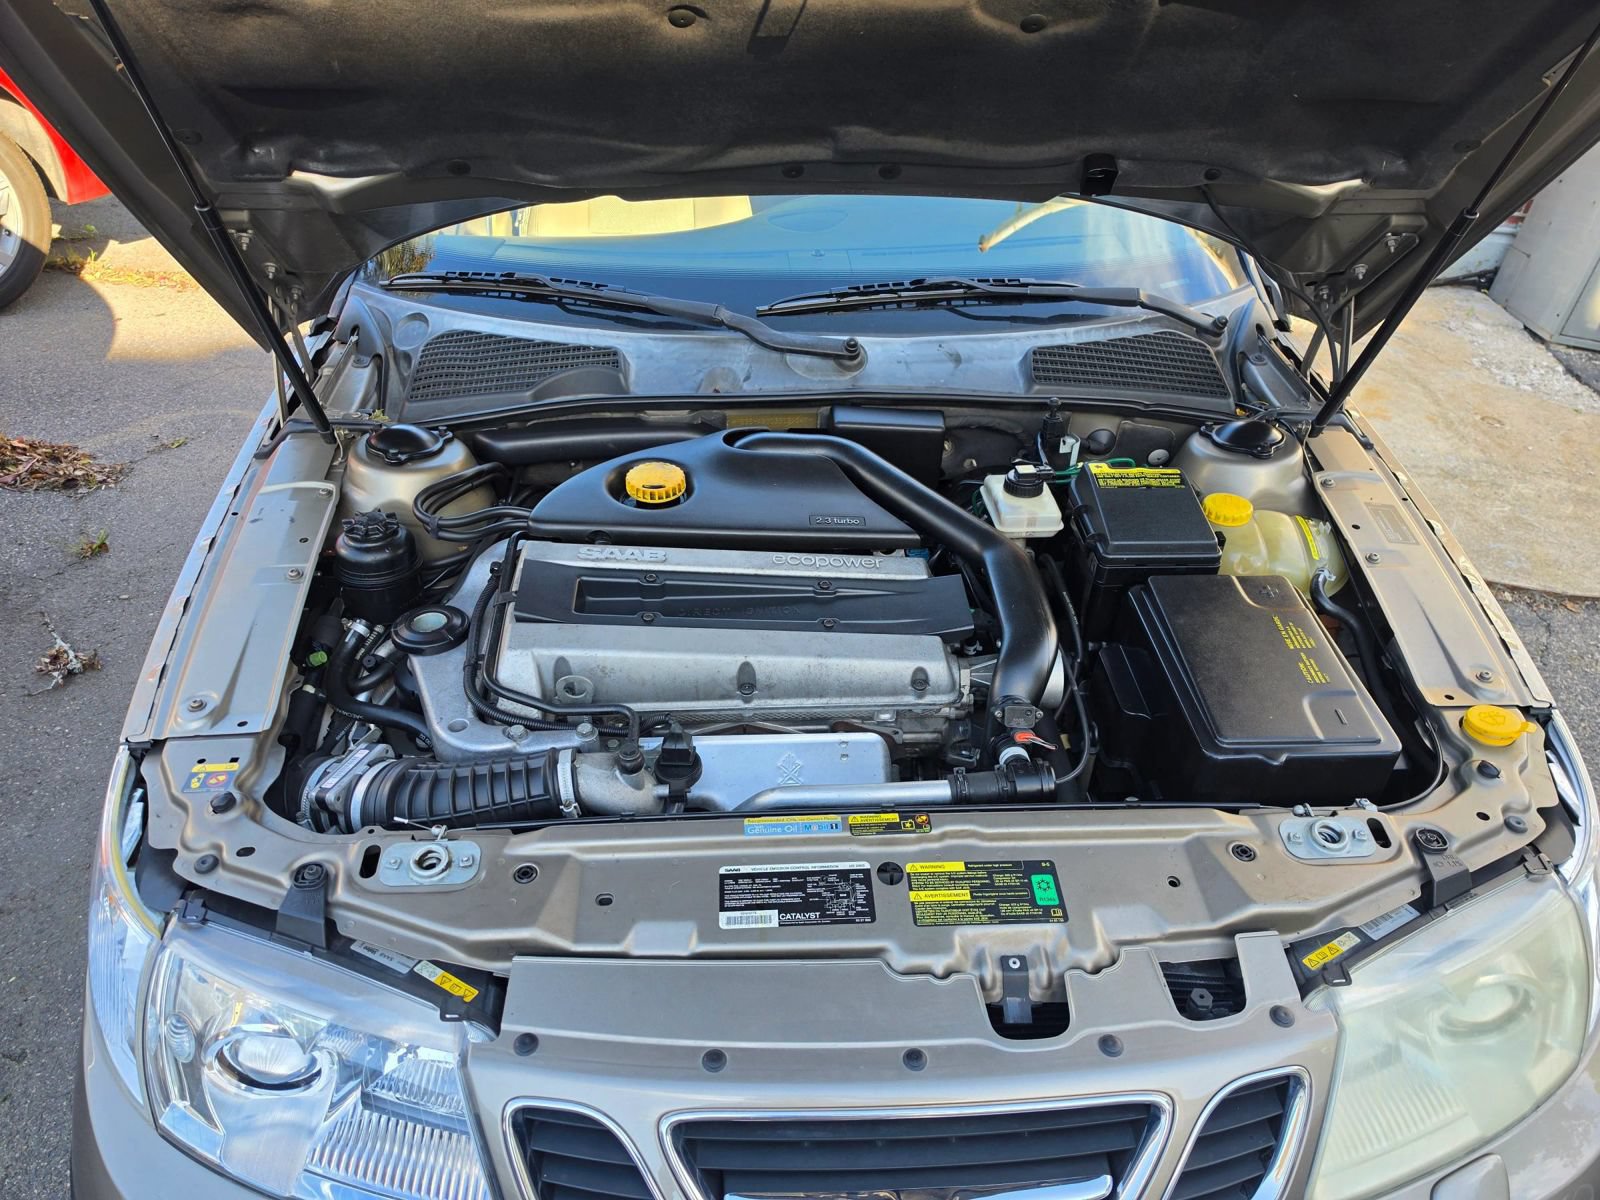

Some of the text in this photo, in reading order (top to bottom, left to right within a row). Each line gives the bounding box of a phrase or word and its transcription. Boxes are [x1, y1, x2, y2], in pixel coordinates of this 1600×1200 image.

[577, 546, 667, 563] SAAB
[771, 554, 884, 568] ecopower
[747, 824, 798, 834] Genuine Oil
[804, 823, 828, 831] Mobil
[779, 912, 821, 920] CATALYST
